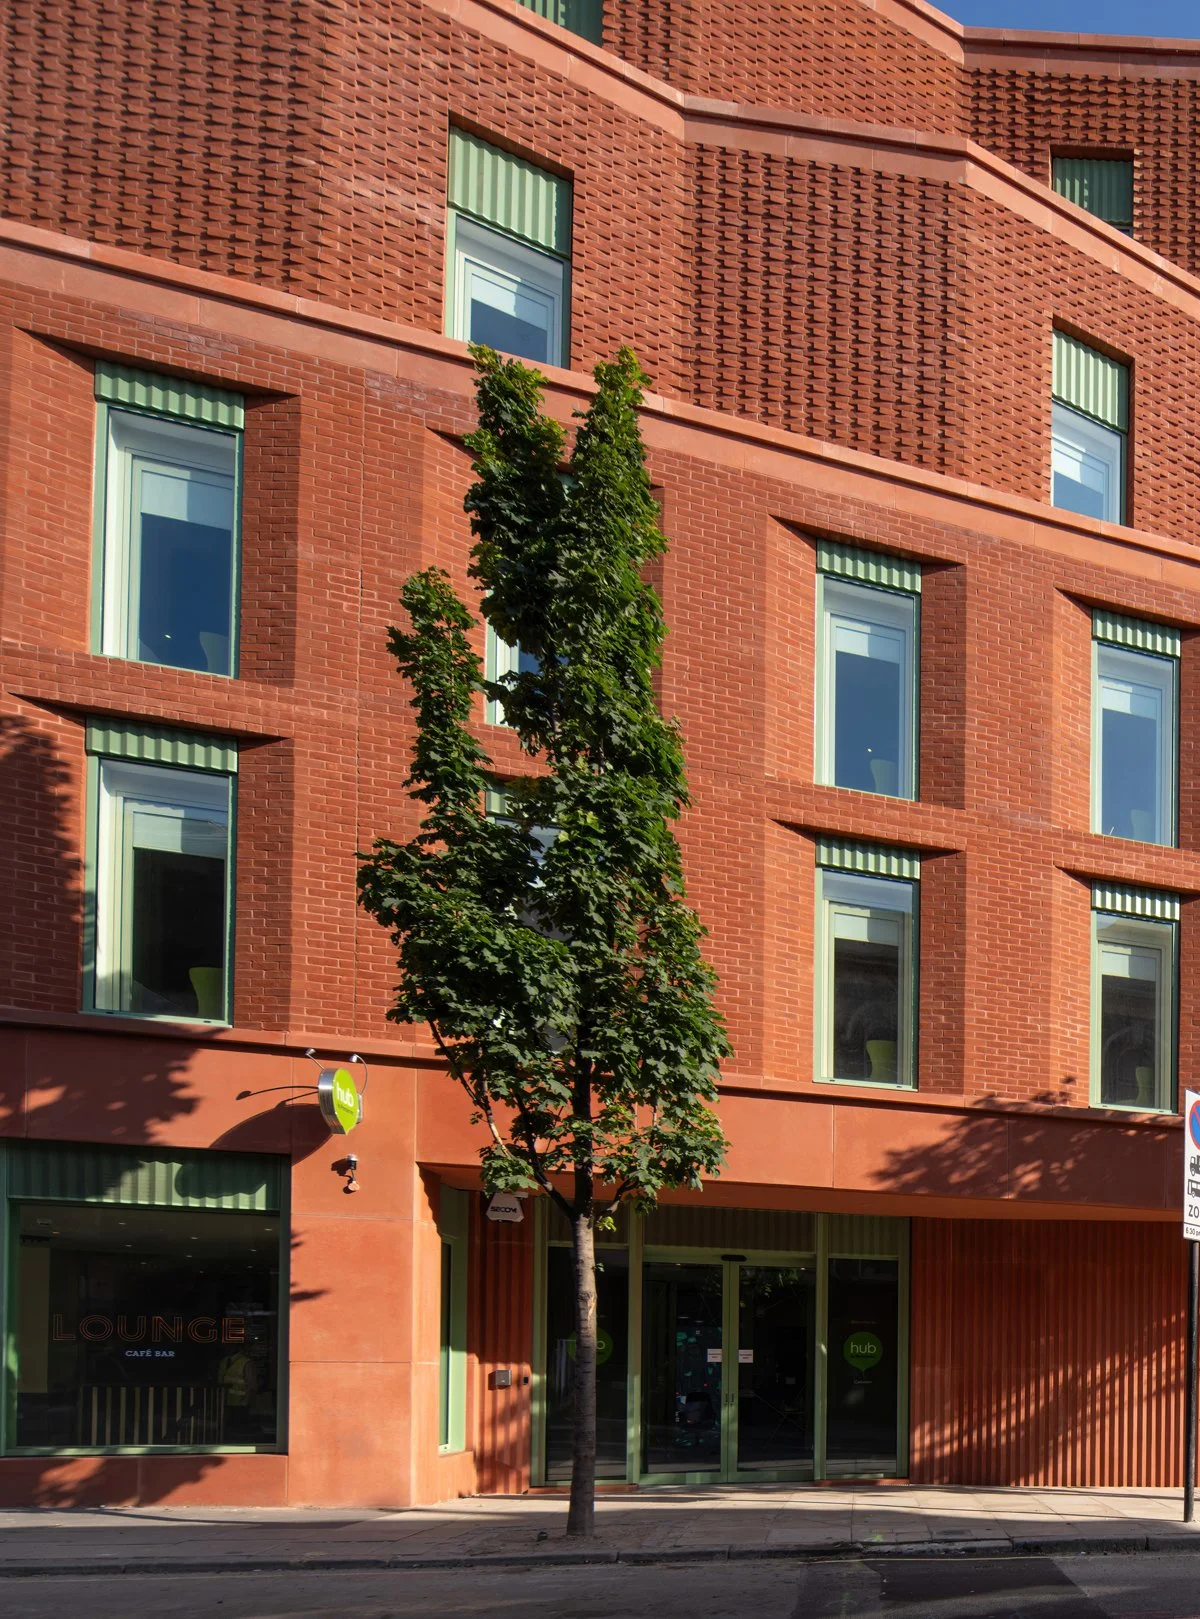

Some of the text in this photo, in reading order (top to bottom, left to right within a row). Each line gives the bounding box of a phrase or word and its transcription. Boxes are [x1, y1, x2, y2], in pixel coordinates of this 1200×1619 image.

[337, 1081, 354, 1107] hub
[52, 1313, 246, 1344] LOUNGE
[125, 1349, 152, 1357] CAFÉ
[850, 1341, 877, 1354] hub
